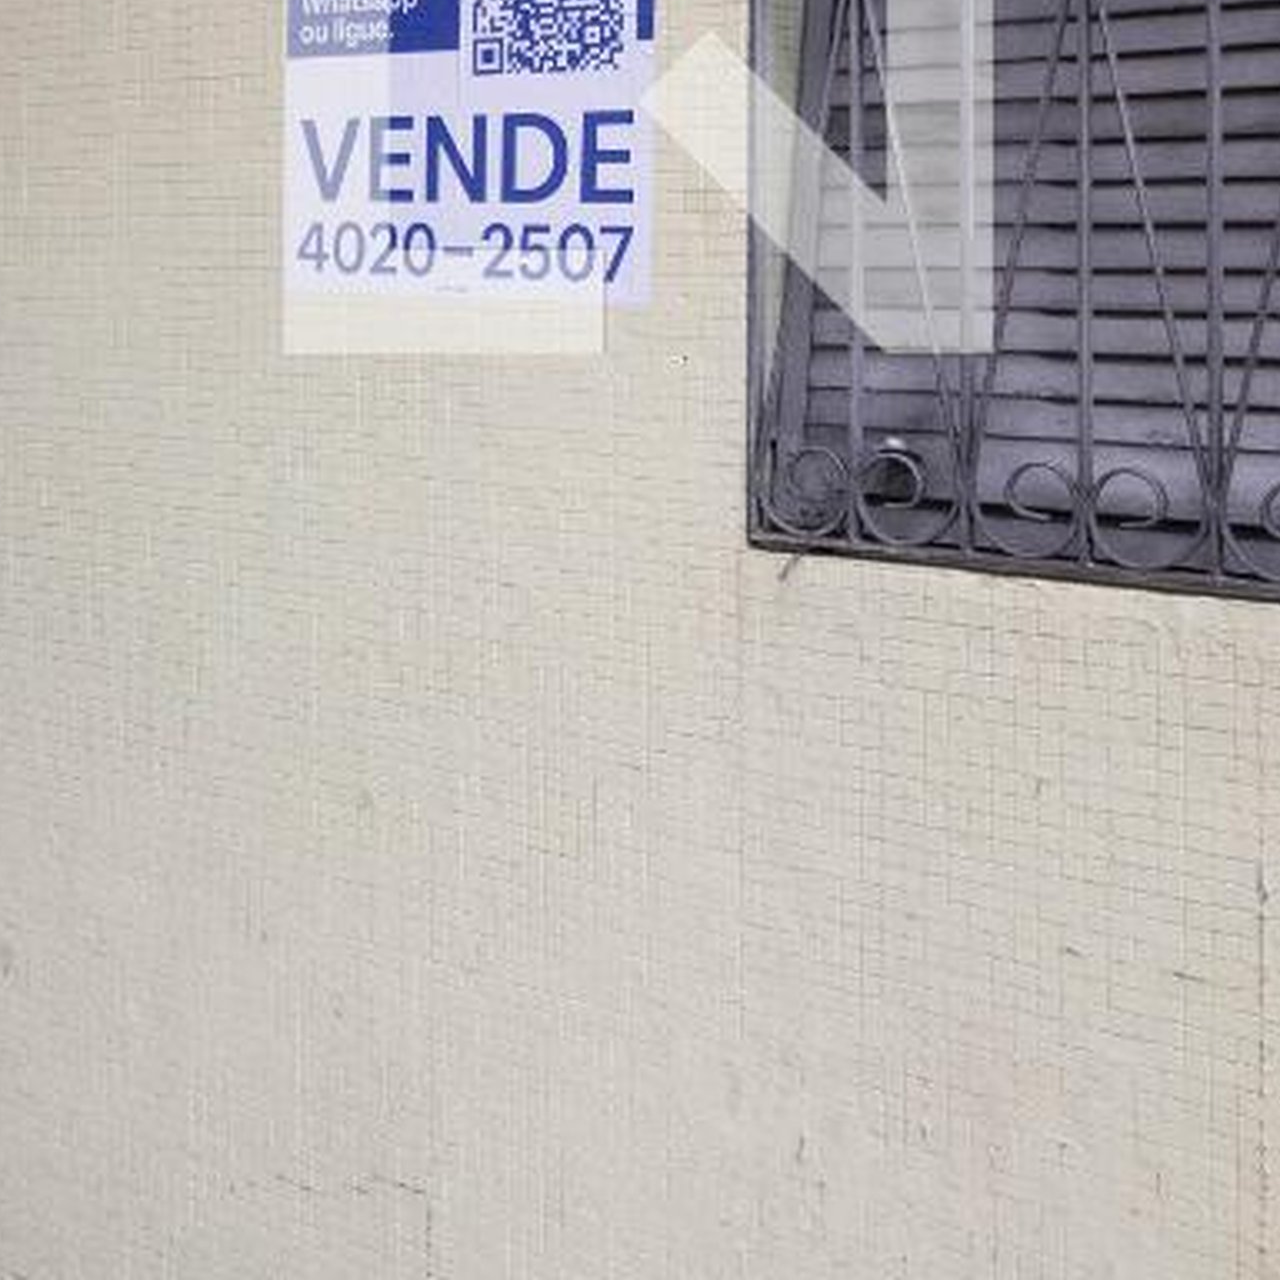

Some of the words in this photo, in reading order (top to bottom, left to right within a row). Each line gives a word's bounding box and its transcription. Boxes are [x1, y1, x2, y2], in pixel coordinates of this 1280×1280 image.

[300, 25, 328, 45] ou
[299, 109, 635, 205] VENDE
[296, 221, 635, 284] 4020-2507
